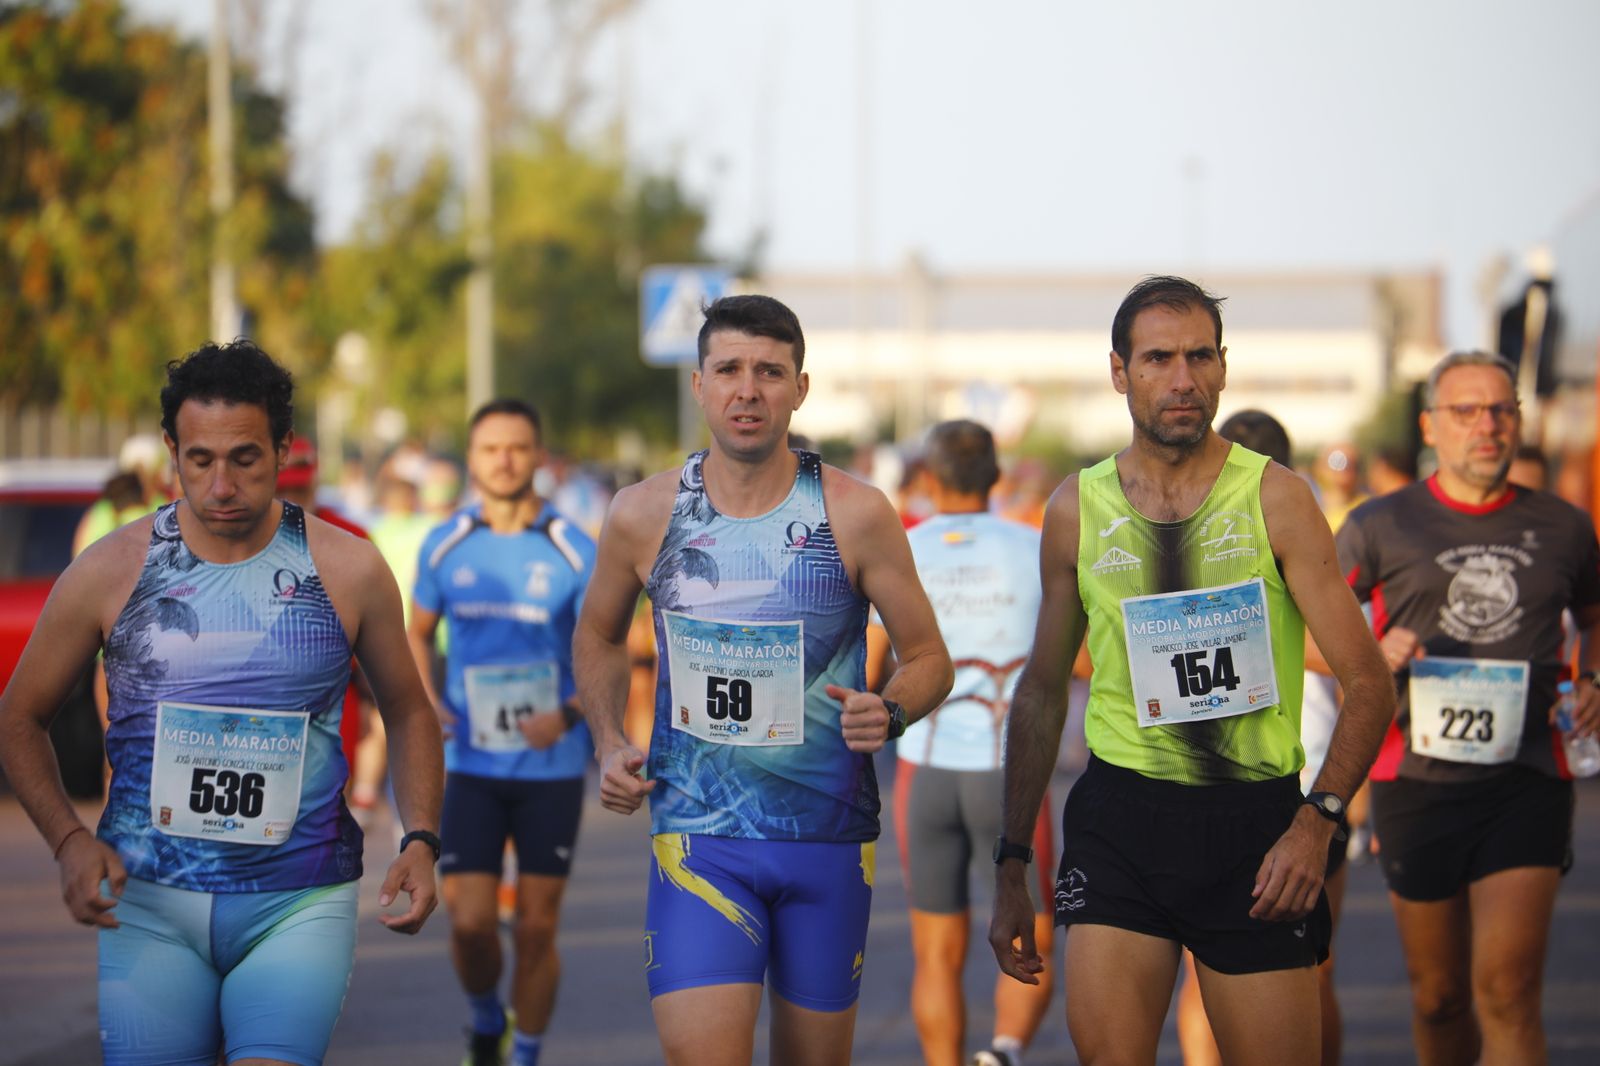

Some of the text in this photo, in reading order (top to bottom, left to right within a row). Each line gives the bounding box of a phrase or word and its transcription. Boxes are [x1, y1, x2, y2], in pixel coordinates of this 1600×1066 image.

[1132, 618, 1182, 636] MEDIA
[1187, 604, 1263, 630] MARATÓN
[672, 633, 797, 659] MEDIA MARATÓN
[1201, 635, 1223, 648] VILLAR
[702, 664, 728, 676] ANTONIO
[1170, 646, 1241, 698] 154
[706, 675, 752, 722] 59
[163, 728, 301, 752] MEDIA MARATÓN
[1440, 707, 1494, 743] 223
[189, 767, 266, 818] 536
